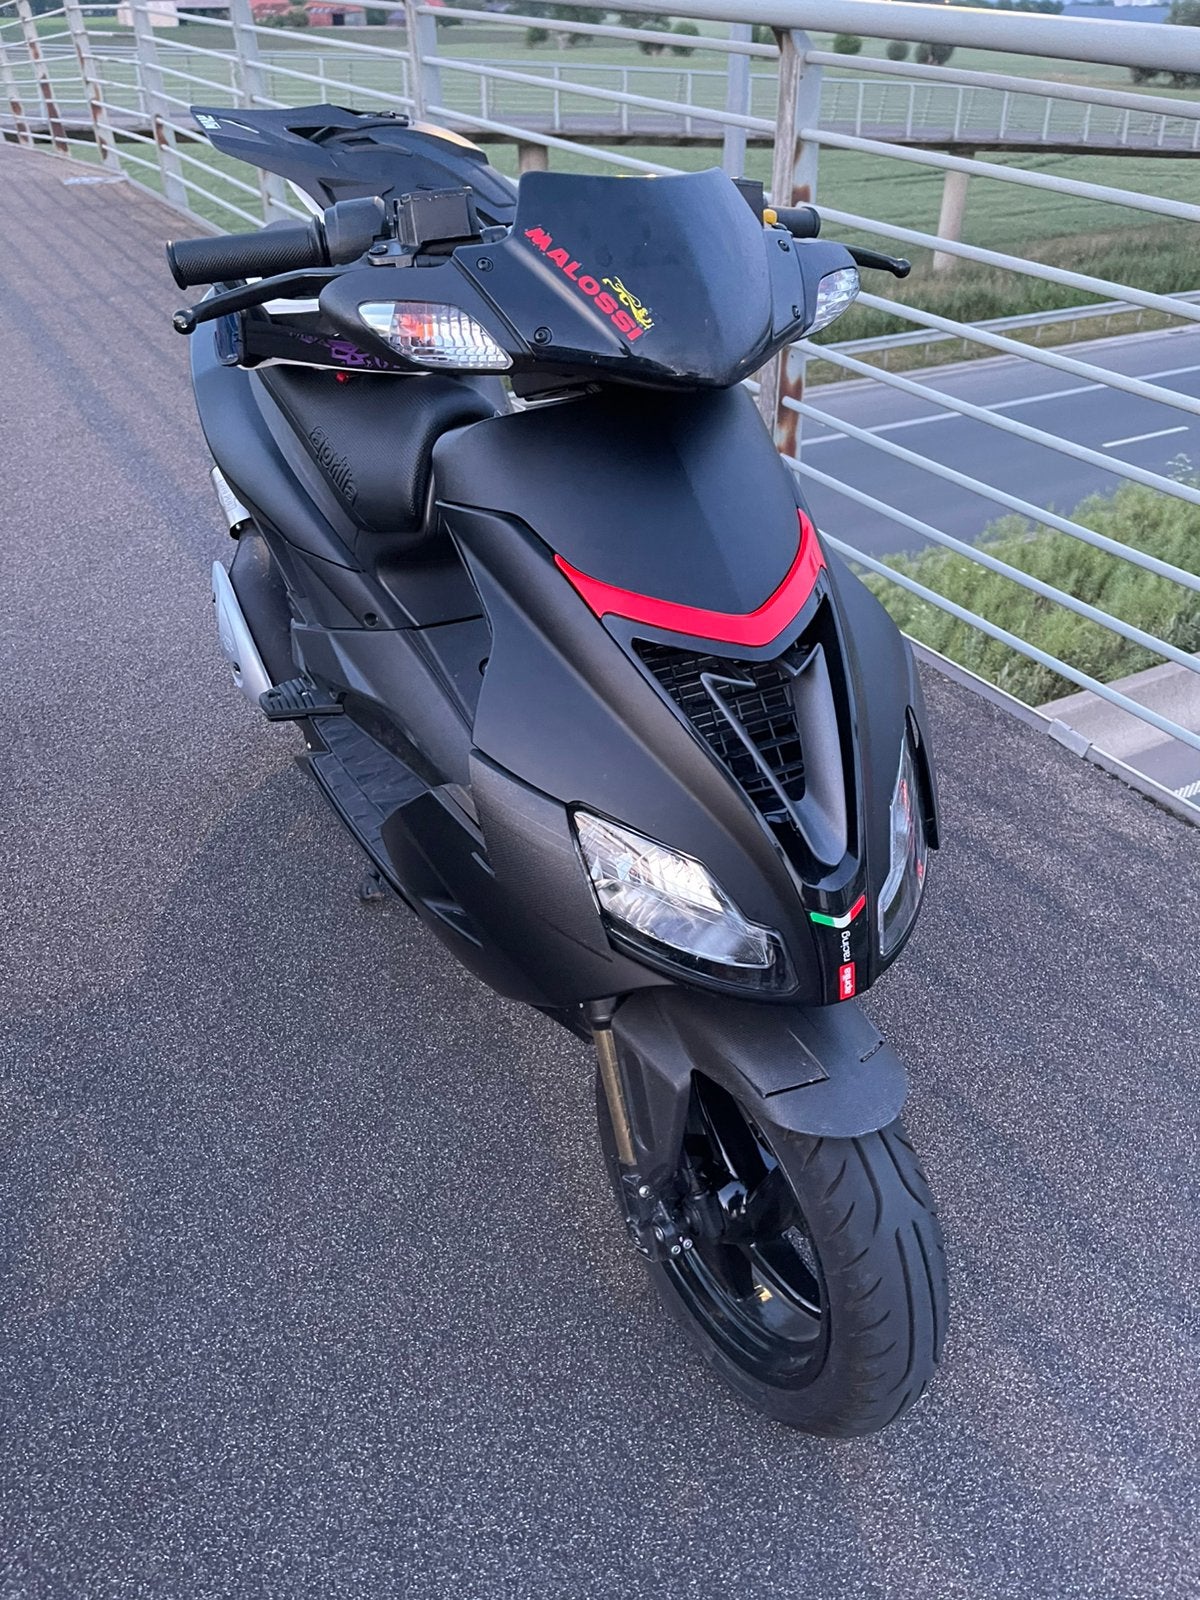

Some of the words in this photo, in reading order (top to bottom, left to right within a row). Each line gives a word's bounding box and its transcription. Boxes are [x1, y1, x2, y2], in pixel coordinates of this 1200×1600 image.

[524, 227, 643, 341] MALOSSI
[309, 425, 358, 507] aprilia
[840, 930, 851, 962] racing
[842, 967, 853, 994] aprilia
